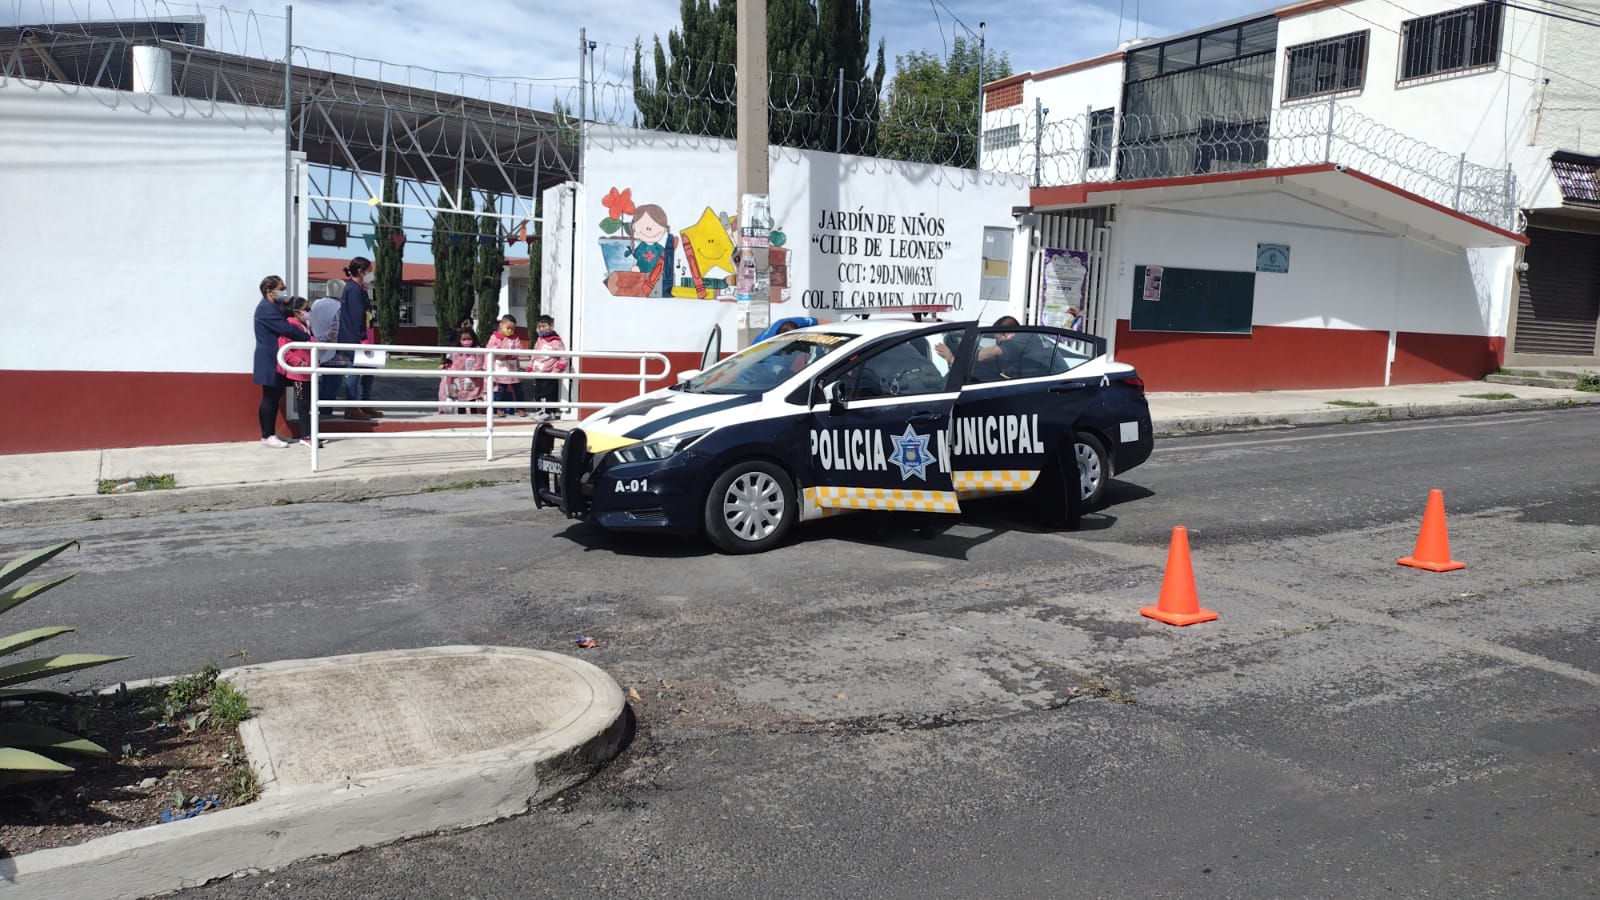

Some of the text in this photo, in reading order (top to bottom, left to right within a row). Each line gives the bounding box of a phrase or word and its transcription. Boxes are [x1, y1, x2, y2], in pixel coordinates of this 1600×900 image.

[818, 205, 945, 236] JARDÍN DE NIÑOS
[864, 237, 882, 257] DE
[838, 262, 933, 286] CCT: 29DJN0063X
[801, 289, 829, 309] COL.
[851, 290, 904, 308] CARMEN
[810, 428, 888, 471] POLICIA
[614, 479, 649, 492] A-01
